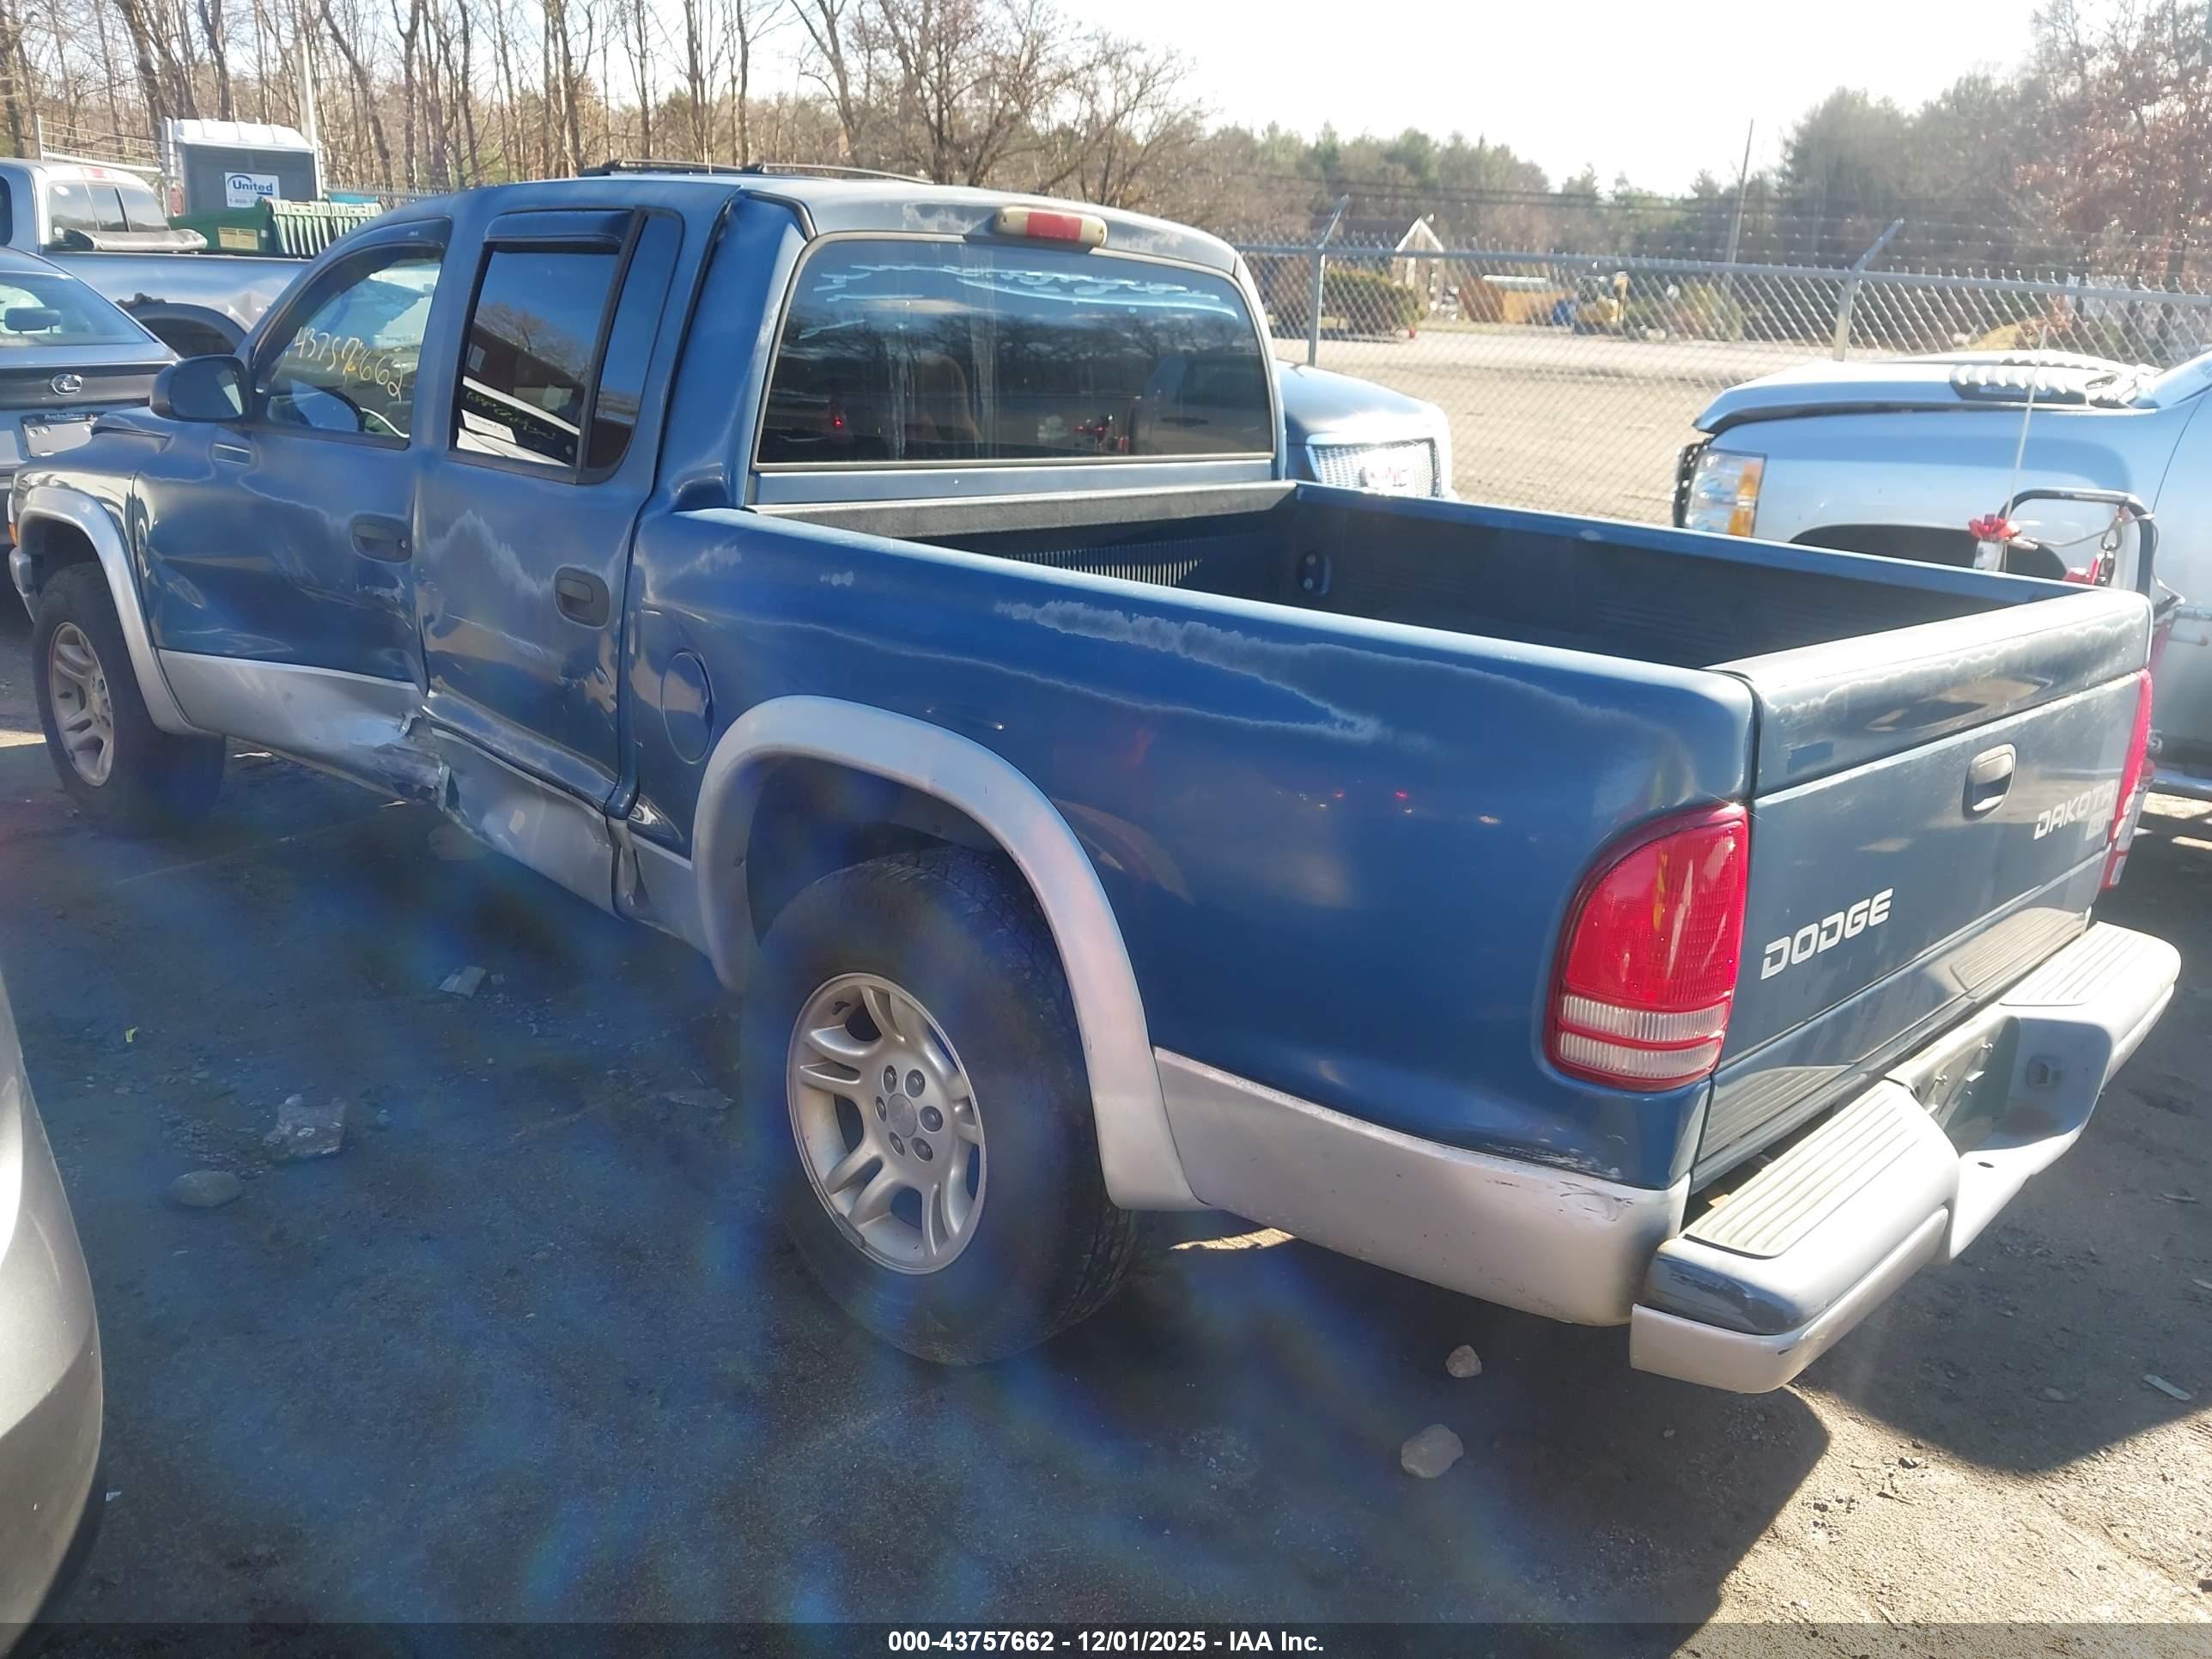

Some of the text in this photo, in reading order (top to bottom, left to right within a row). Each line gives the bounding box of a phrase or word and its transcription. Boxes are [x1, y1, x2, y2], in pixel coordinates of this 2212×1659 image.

[233, 179, 273, 192] United
[2033, 779, 2116, 841] DAKOTA
[1760, 888, 1893, 981] DODGE
